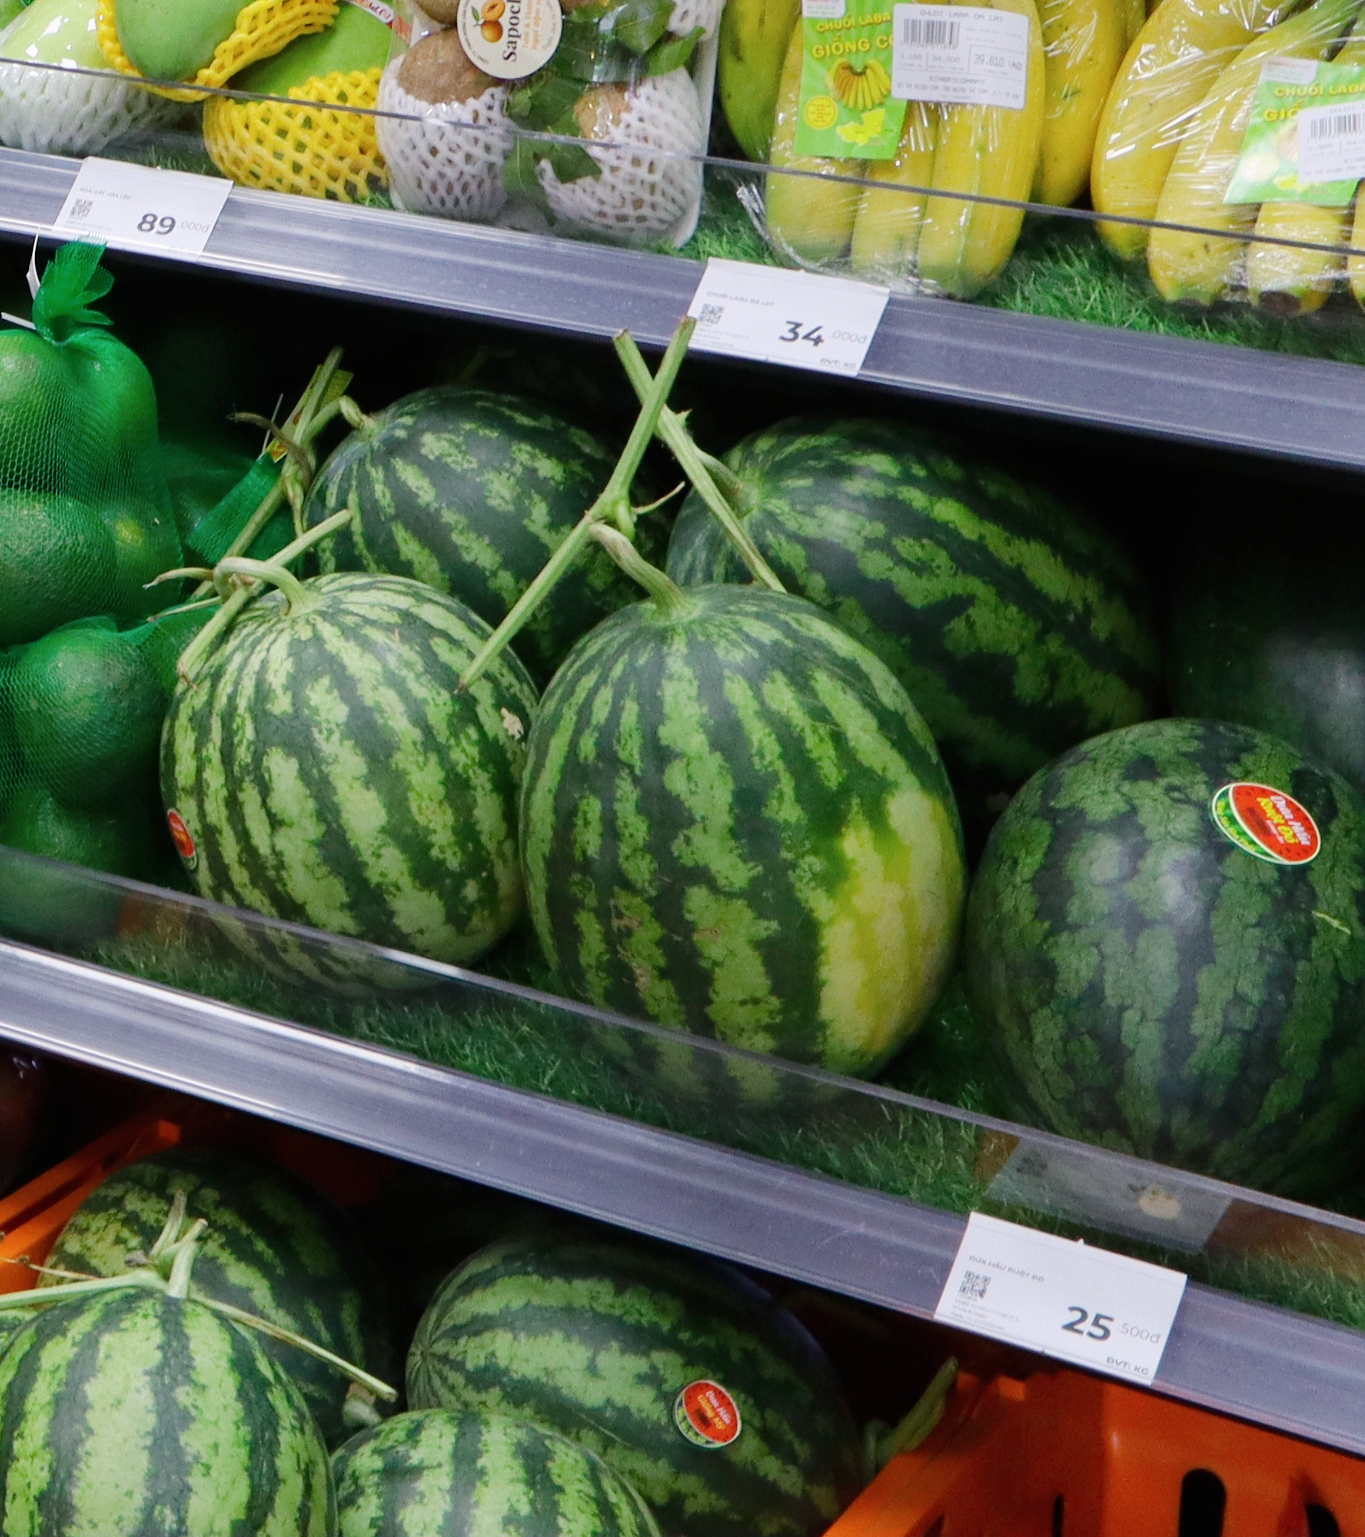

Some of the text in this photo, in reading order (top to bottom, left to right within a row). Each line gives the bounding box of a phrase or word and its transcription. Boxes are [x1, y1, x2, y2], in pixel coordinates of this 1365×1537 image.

[816, 12, 892, 33] CHUỐI LABA
[811, 32, 871, 60] GIỐNG
[136, 212, 177, 236] 89
[778, 319, 825, 347] 34
[1060, 1305, 1116, 1342] 25
[1133, 1365, 1150, 1376] KG
